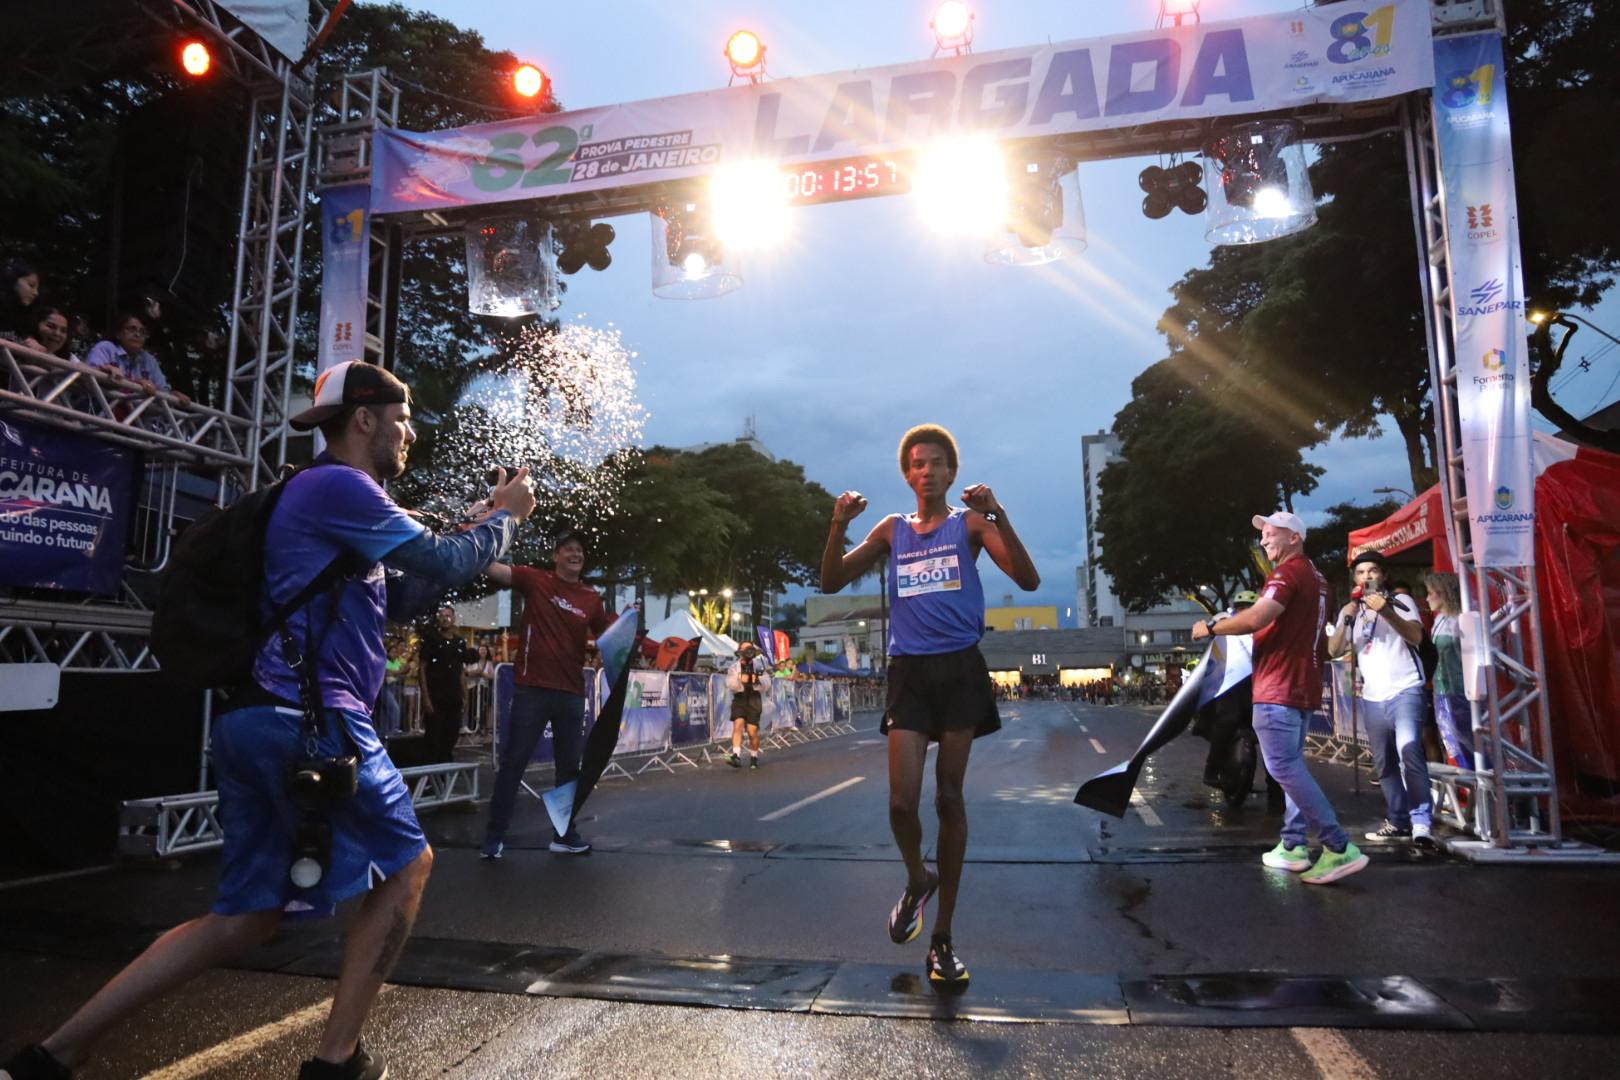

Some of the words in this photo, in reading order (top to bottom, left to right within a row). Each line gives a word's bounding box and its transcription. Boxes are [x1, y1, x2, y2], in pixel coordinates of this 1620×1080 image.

[1327, 4, 1395, 64] 81
[1332, 66, 1396, 84] APUCARANA
[752, 28, 1255, 158] LARGADA
[581, 142, 622, 159] PROVA
[624, 133, 690, 150] PEDESTRE
[573, 161, 598, 181] 28
[601, 162, 619, 174] de
[621, 146, 719, 172] JANEIRO
[1467, 230, 1497, 240] COPEL
[1458, 301, 1521, 316] SANEPAR
[72, 471, 89, 484] DE
[22, 511, 47, 528] das
[49, 518, 98, 535] pessoas
[1477, 512, 1536, 523] APUCARANA
[45, 535, 54, 546] o
[56, 534, 95, 551] futuro
[910, 567, 950, 586] 5001
